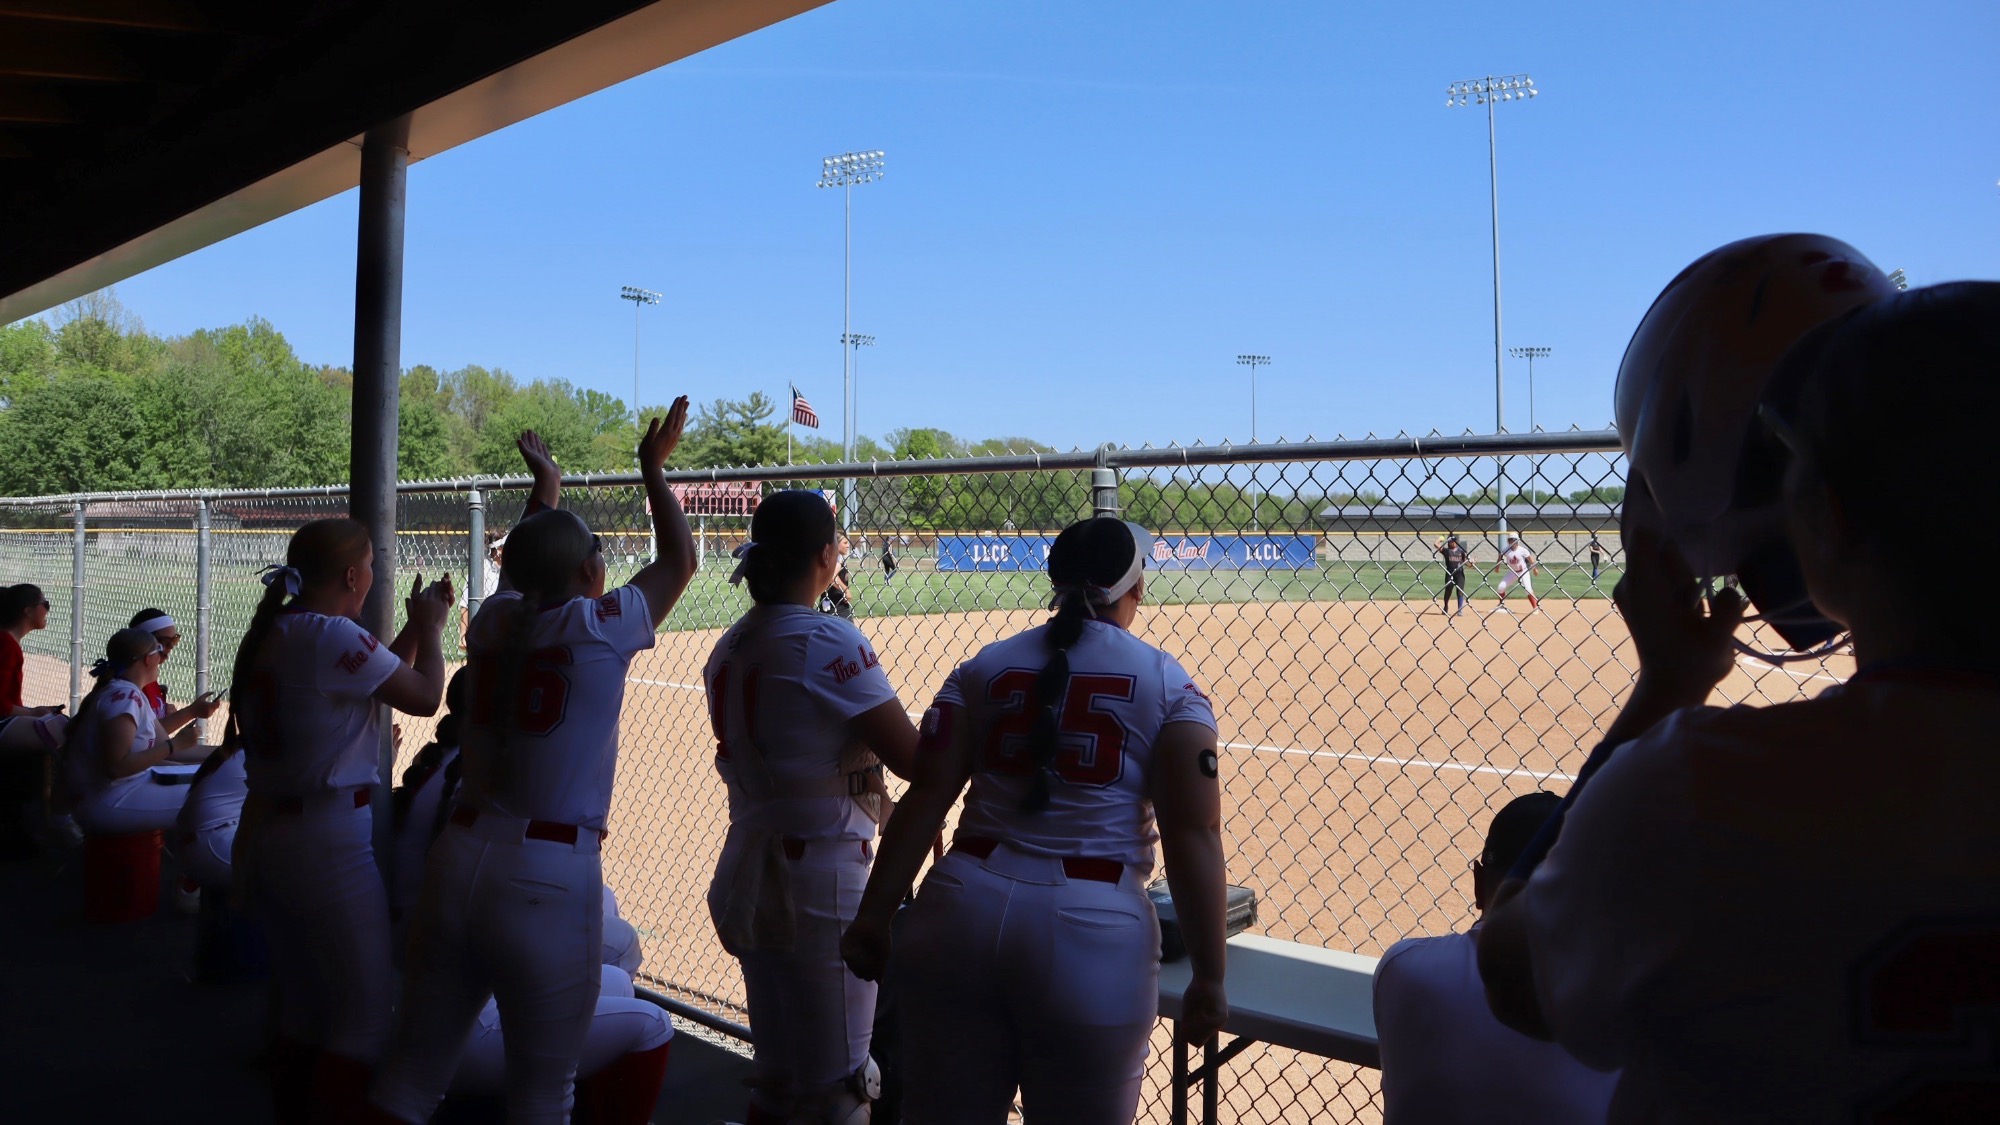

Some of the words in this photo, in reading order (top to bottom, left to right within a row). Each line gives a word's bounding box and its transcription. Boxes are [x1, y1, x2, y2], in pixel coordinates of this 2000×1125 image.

[1153, 540, 1174, 561] The
[1177, 538, 1211, 560] Land
[1245, 543, 1282, 561] LLCC
[823, 655, 861, 685] The
[984, 666, 1138, 790] 25
